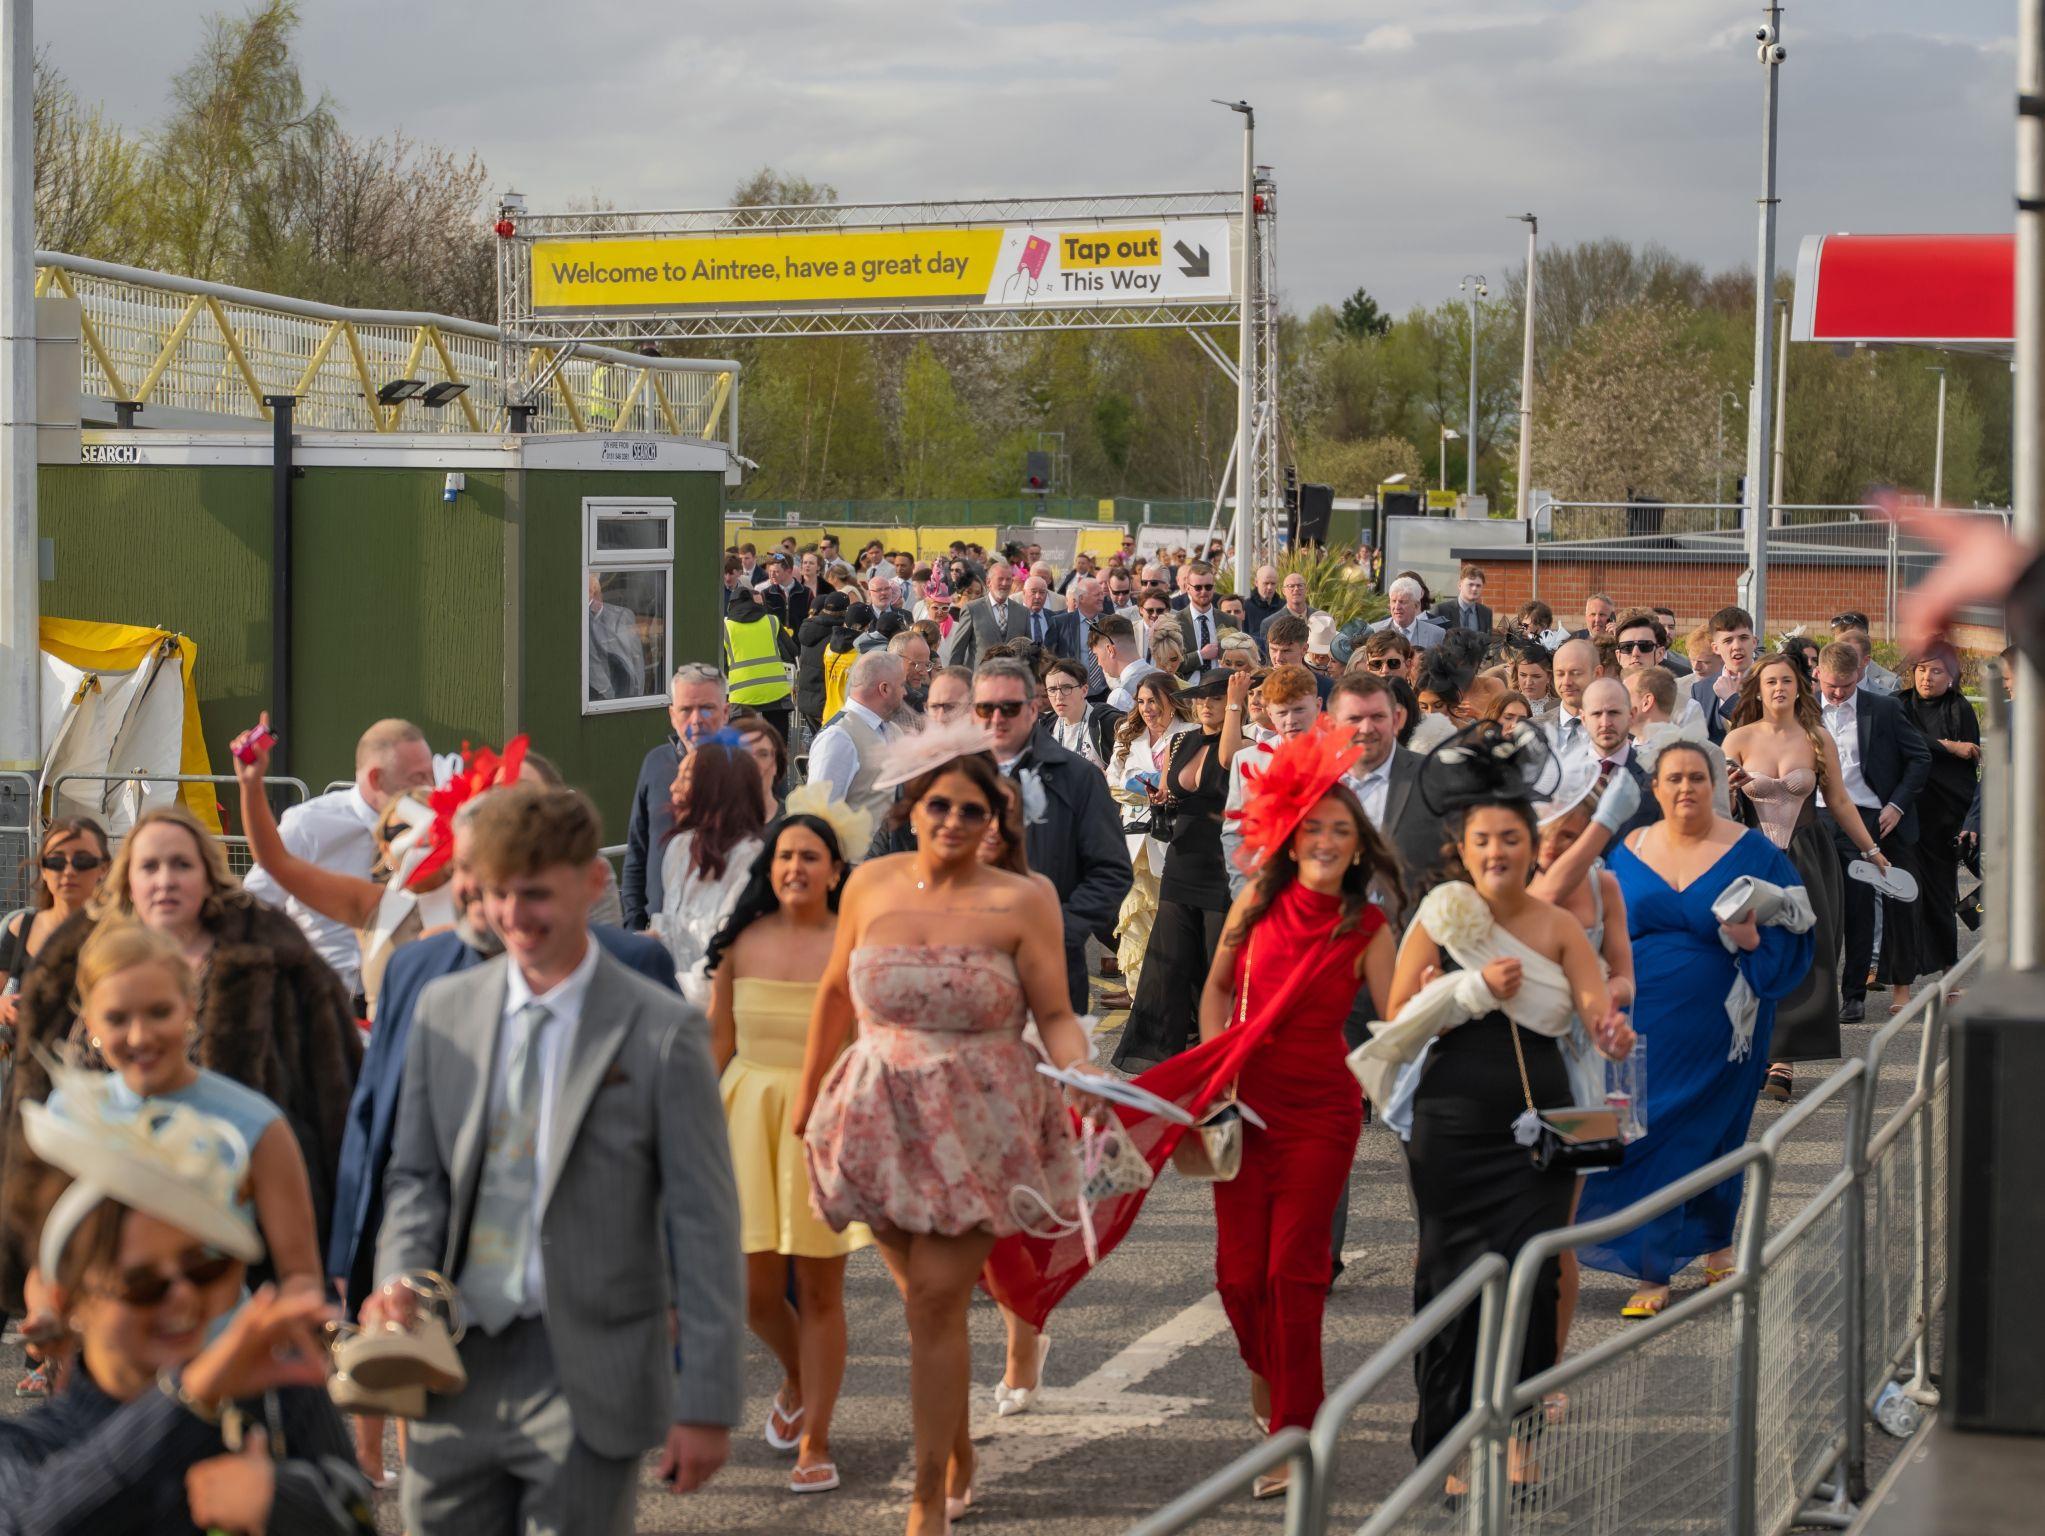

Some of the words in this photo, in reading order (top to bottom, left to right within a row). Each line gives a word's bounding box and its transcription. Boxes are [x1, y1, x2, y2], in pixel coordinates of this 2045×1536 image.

[1064, 238, 1110, 264] Tap
[1116, 237, 1159, 258] out
[552, 261, 658, 285] Welcome
[663, 262, 687, 282] to
[692, 257, 780, 282] Aintree,
[785, 255, 838, 279] have
[843, 261, 856, 278] a
[861, 252, 921, 283] great
[926, 250, 969, 280] day
[1060, 272, 1104, 292] This
[1110, 270, 1162, 293] Way
[82, 445, 134, 462] SEARCH
